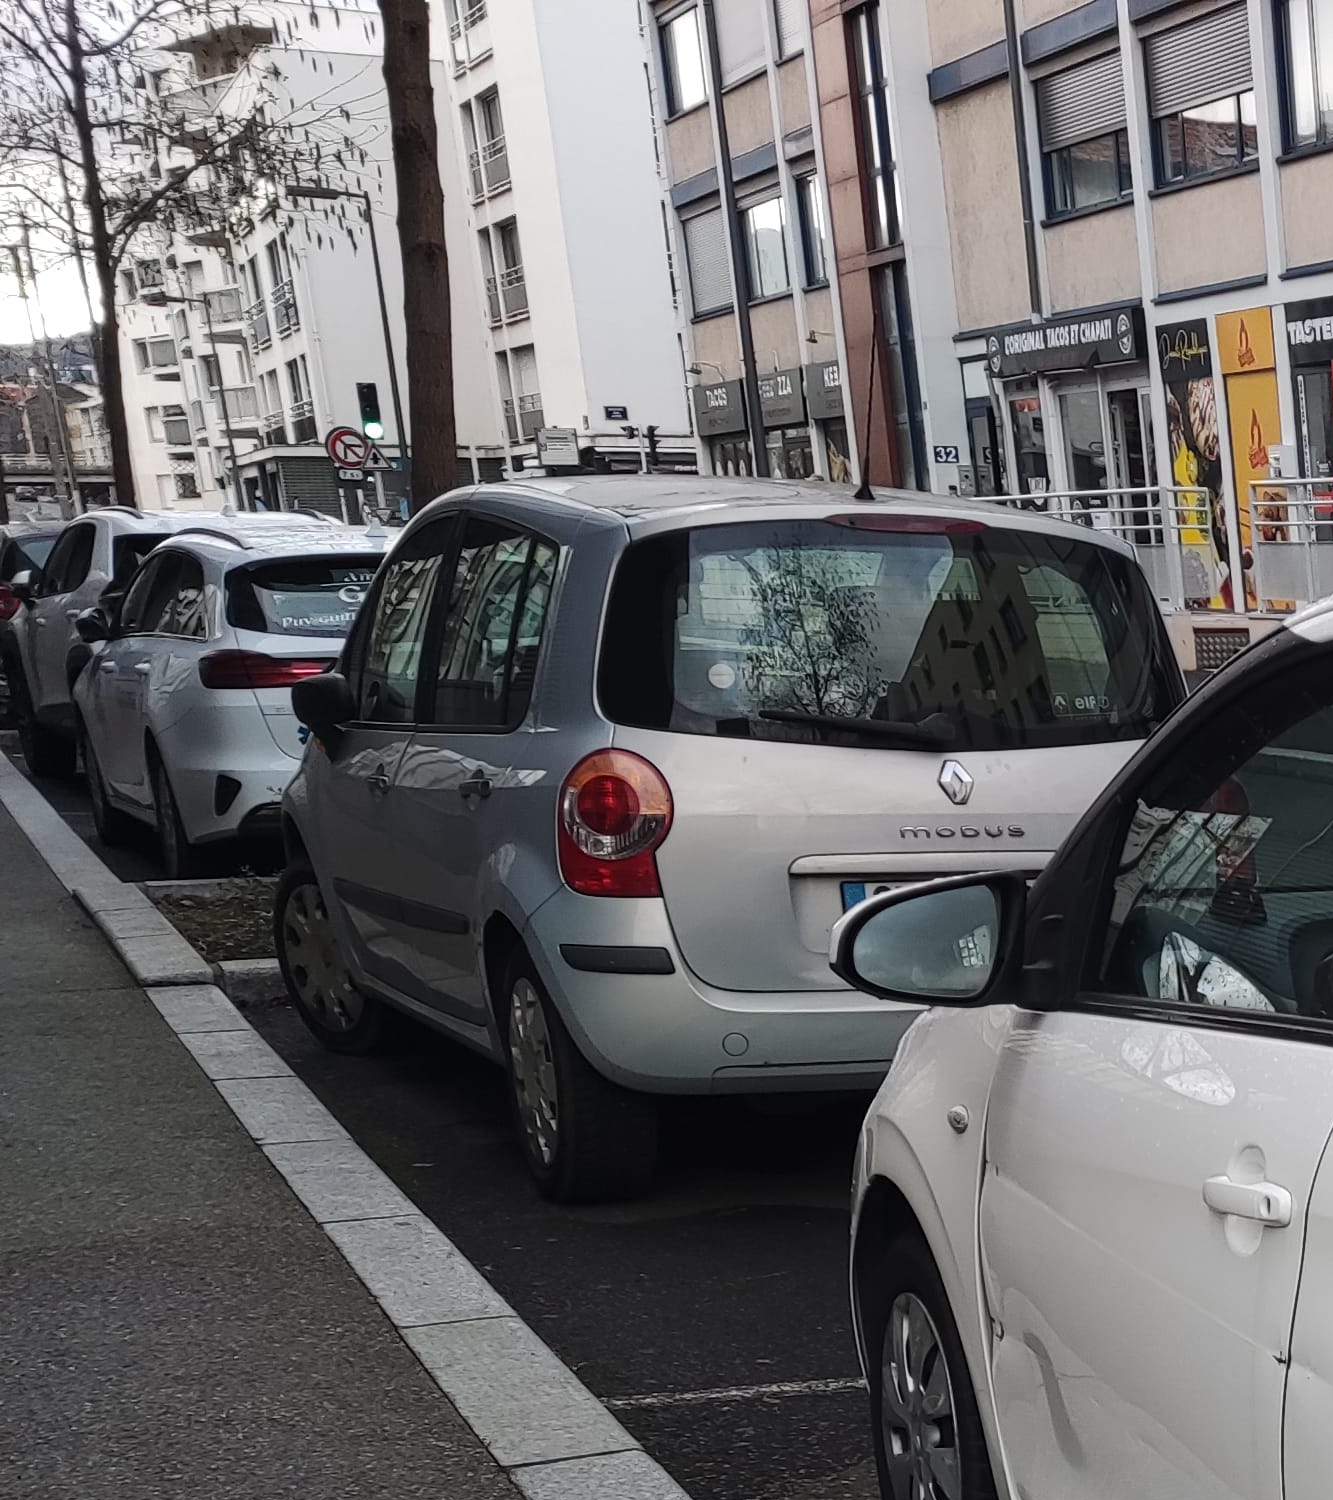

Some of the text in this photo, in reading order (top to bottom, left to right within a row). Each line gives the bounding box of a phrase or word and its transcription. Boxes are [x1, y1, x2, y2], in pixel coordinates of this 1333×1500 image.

[1046, 325, 1070, 349] TACOS
[1070, 323, 1080, 345] ET
[705, 387, 728, 408] TACOS
[935, 447, 958, 463] 32
[1074, 695, 1096, 710] elf
